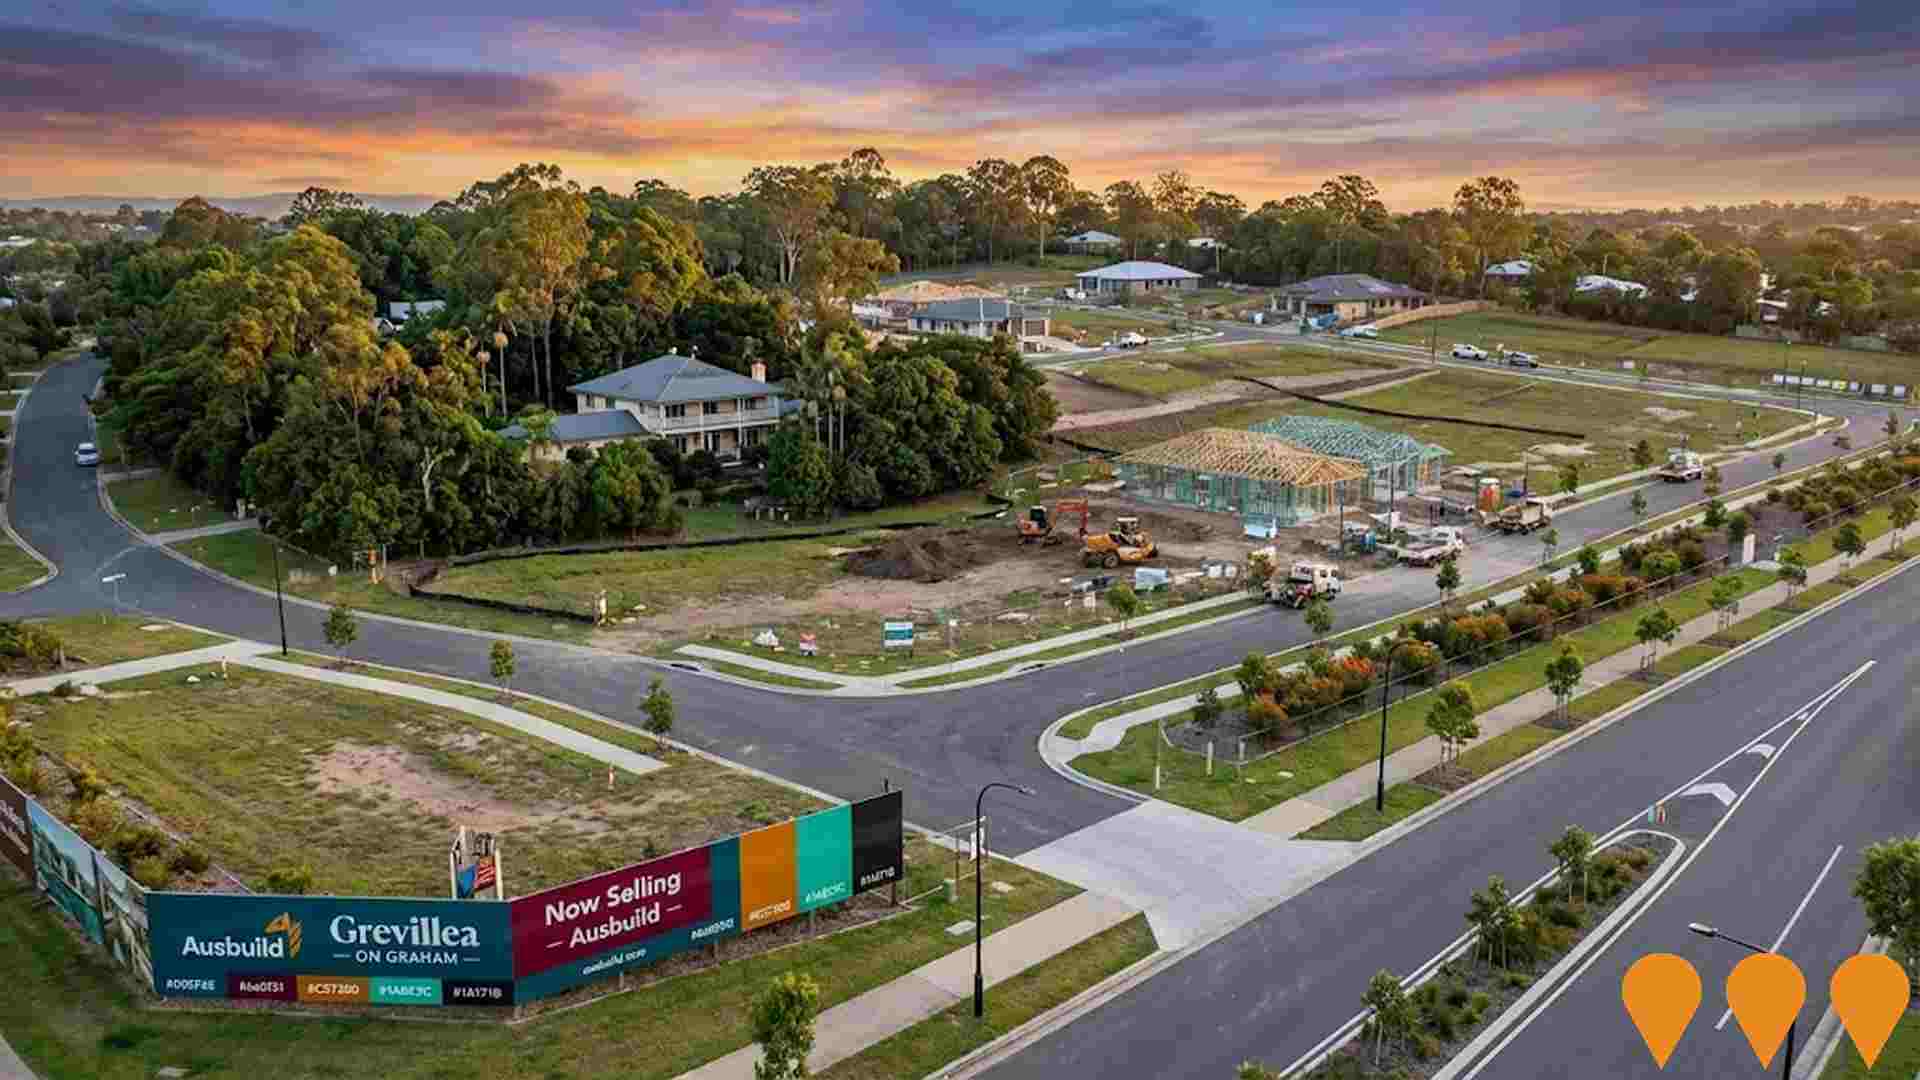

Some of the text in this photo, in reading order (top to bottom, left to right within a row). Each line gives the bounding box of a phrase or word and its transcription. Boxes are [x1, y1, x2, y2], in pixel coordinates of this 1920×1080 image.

[543, 872, 682, 927] Now Selling
[329, 914, 480, 948] Grevillea
[569, 901, 661, 948] Ausbuild
[181, 935, 284, 958] Ausbuild
[355, 950, 458, 965] ON GRAHAM
